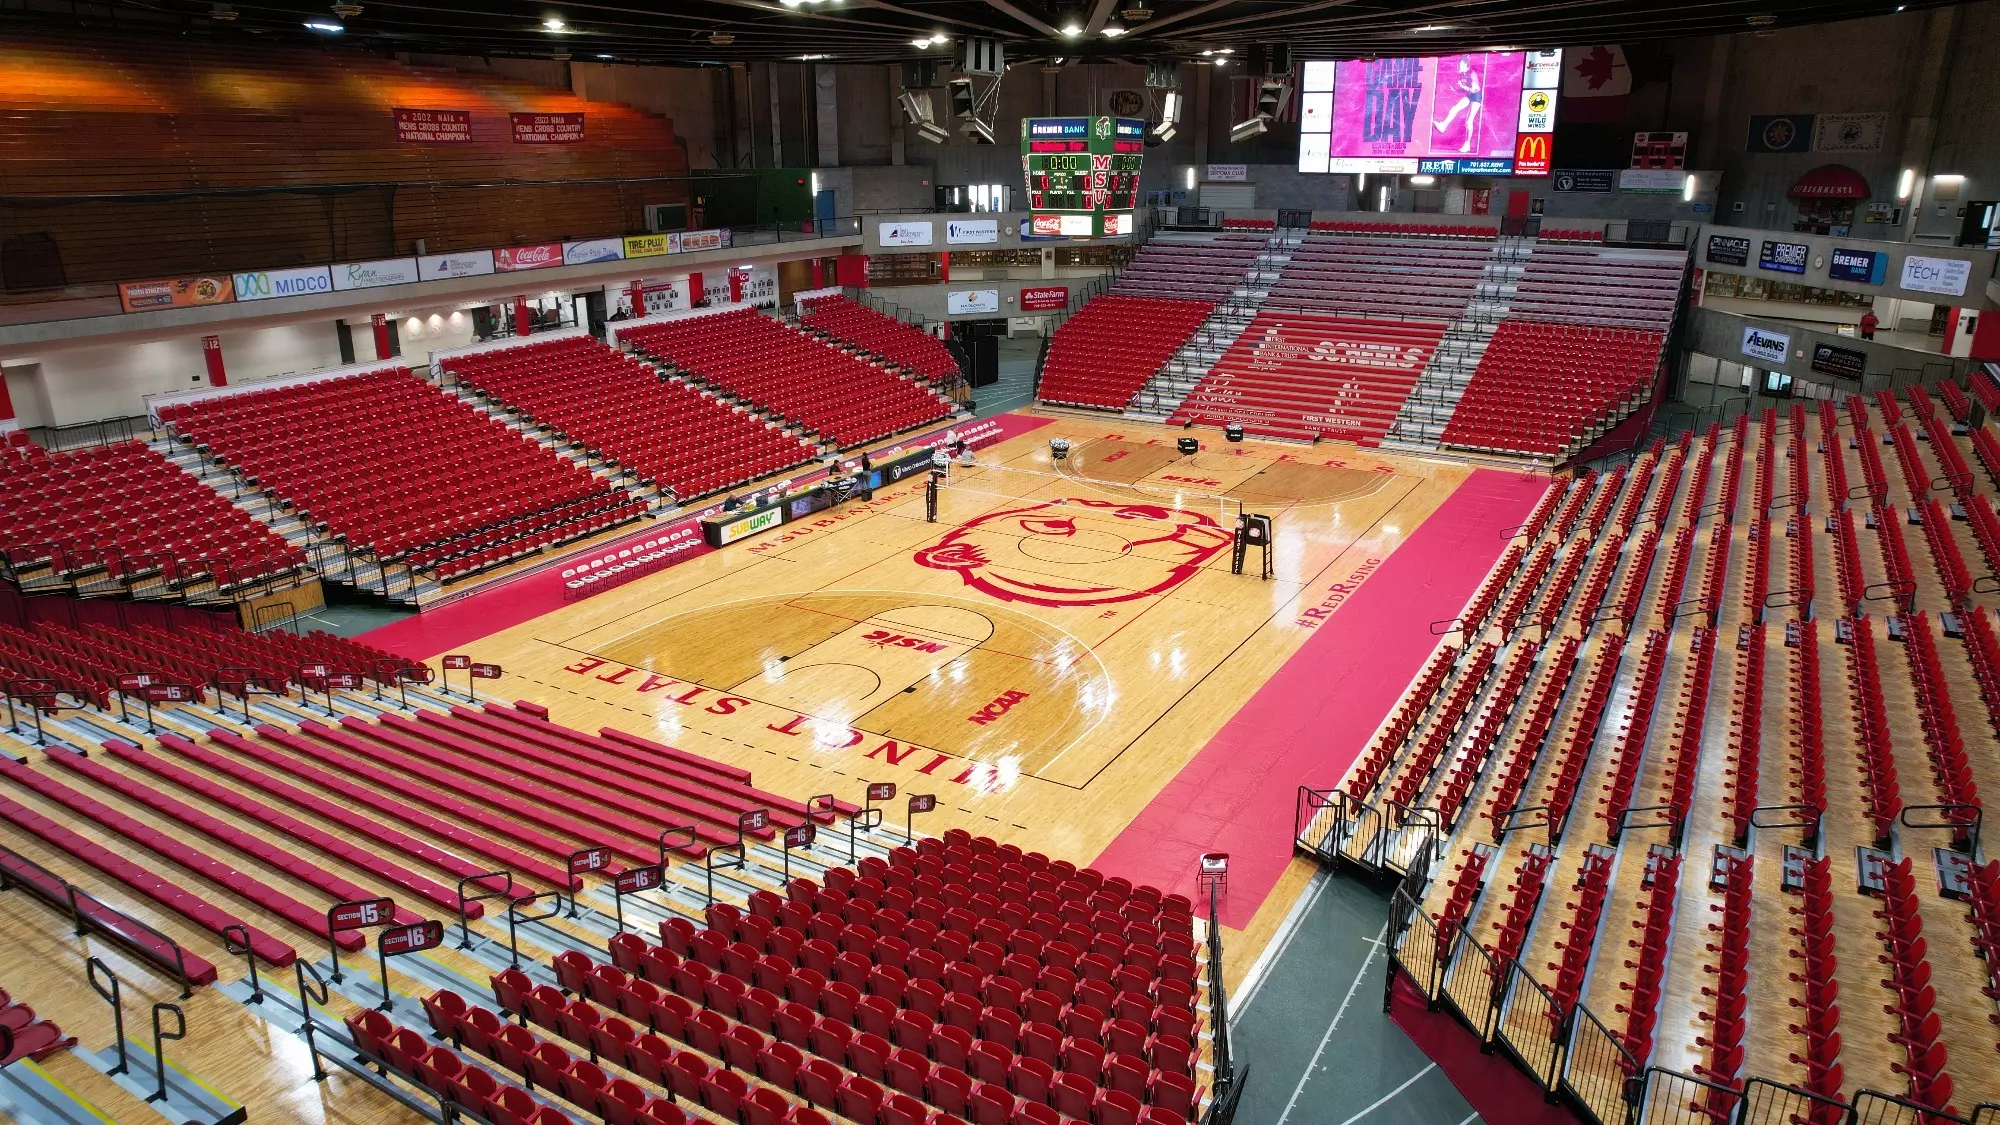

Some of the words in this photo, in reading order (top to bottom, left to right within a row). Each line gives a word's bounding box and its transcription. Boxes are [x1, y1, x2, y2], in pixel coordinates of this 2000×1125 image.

[412, 113, 431, 121] 2002
[535, 116, 549, 124] 2003
[1364, 89, 1422, 142] DAY
[419, 123, 439, 131] CROSS
[442, 124, 468, 132] COUNTRY
[1064, 126, 1085, 134] BANK
[406, 132, 435, 140] NATIONAL
[1051, 156, 1077, 170] 0:00
[1093, 155, 1111, 204] MSU
[1793, 186, 1852, 194] RESHMENTS
[628, 240, 647, 249] TIRES
[1776, 244, 1806, 259] PREMIER
[1833, 255, 1868, 267] BREMER
[1909, 258, 1923, 266] PRO
[346, 264, 376, 287] Ryan
[1908, 266, 1940, 280] TECH
[276, 276, 327, 294] MIDCO
[209, 340, 219, 349] 12
[1265, 343, 1309, 352] INTERNATIONAL
[1832, 352, 1862, 363] UNIVERSAL
[1302, 415, 1323, 423] FIRST
[1324, 416, 1361, 426] WESTERN
[729, 511, 775, 538] SUBWAY
[456, 658, 464, 667] 14
[315, 666, 325, 676] 14
[484, 666, 492, 676] 15
[138, 675, 151, 687] 14
[342, 675, 352, 686] 15
[563, 656, 751, 714] STATE
[167, 686, 180, 698] 15
[968, 690, 1030, 725] NCAA
[881, 786, 888, 798] 15
[919, 797, 927, 809] 16
[753, 813, 762, 827] 15
[797, 829, 806, 842] 16
[574, 858, 589, 866] SECTION
[588, 852, 600, 868] 15
[635, 871, 648, 887] 16
[337, 912, 361, 921] SECTION
[360, 904, 378, 924] 15
[385, 935, 407, 945] SECTION
[407, 927, 425, 947] 16
